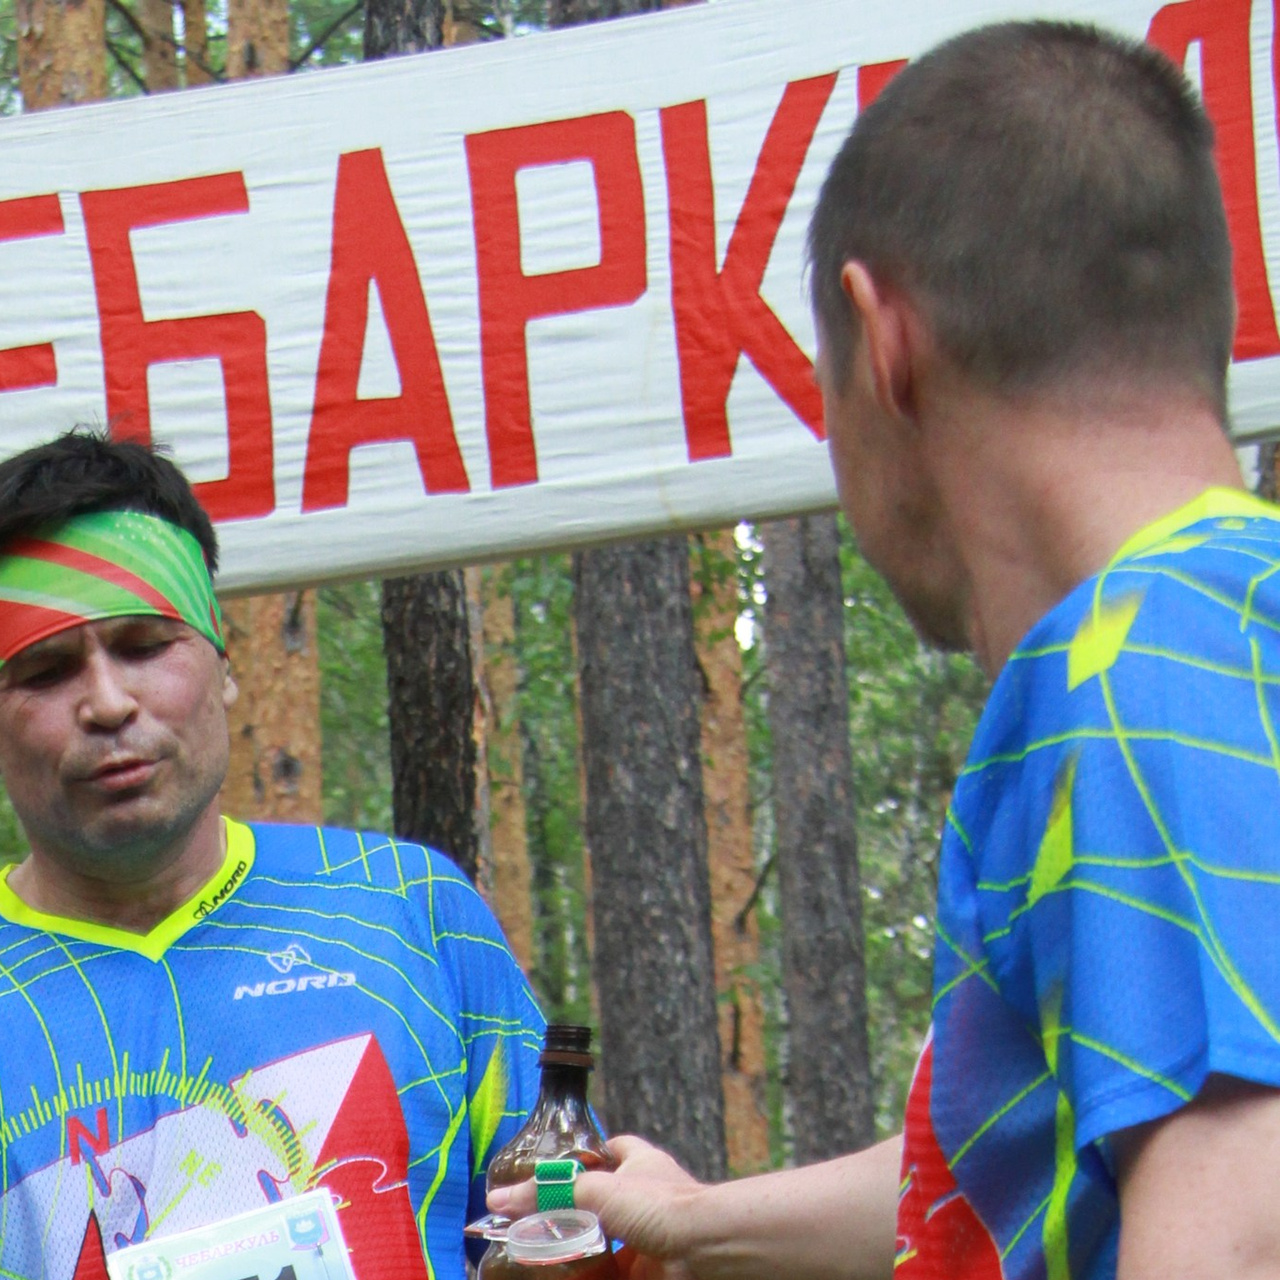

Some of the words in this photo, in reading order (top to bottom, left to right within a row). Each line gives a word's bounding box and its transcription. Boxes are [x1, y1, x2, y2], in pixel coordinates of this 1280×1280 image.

[212, 860, 247, 906] NORD
[233, 972, 357, 1000] NORD
[67, 1106, 111, 1166] N
[176, 1231, 280, 1269] ЧЕБАРКУЛЬ
